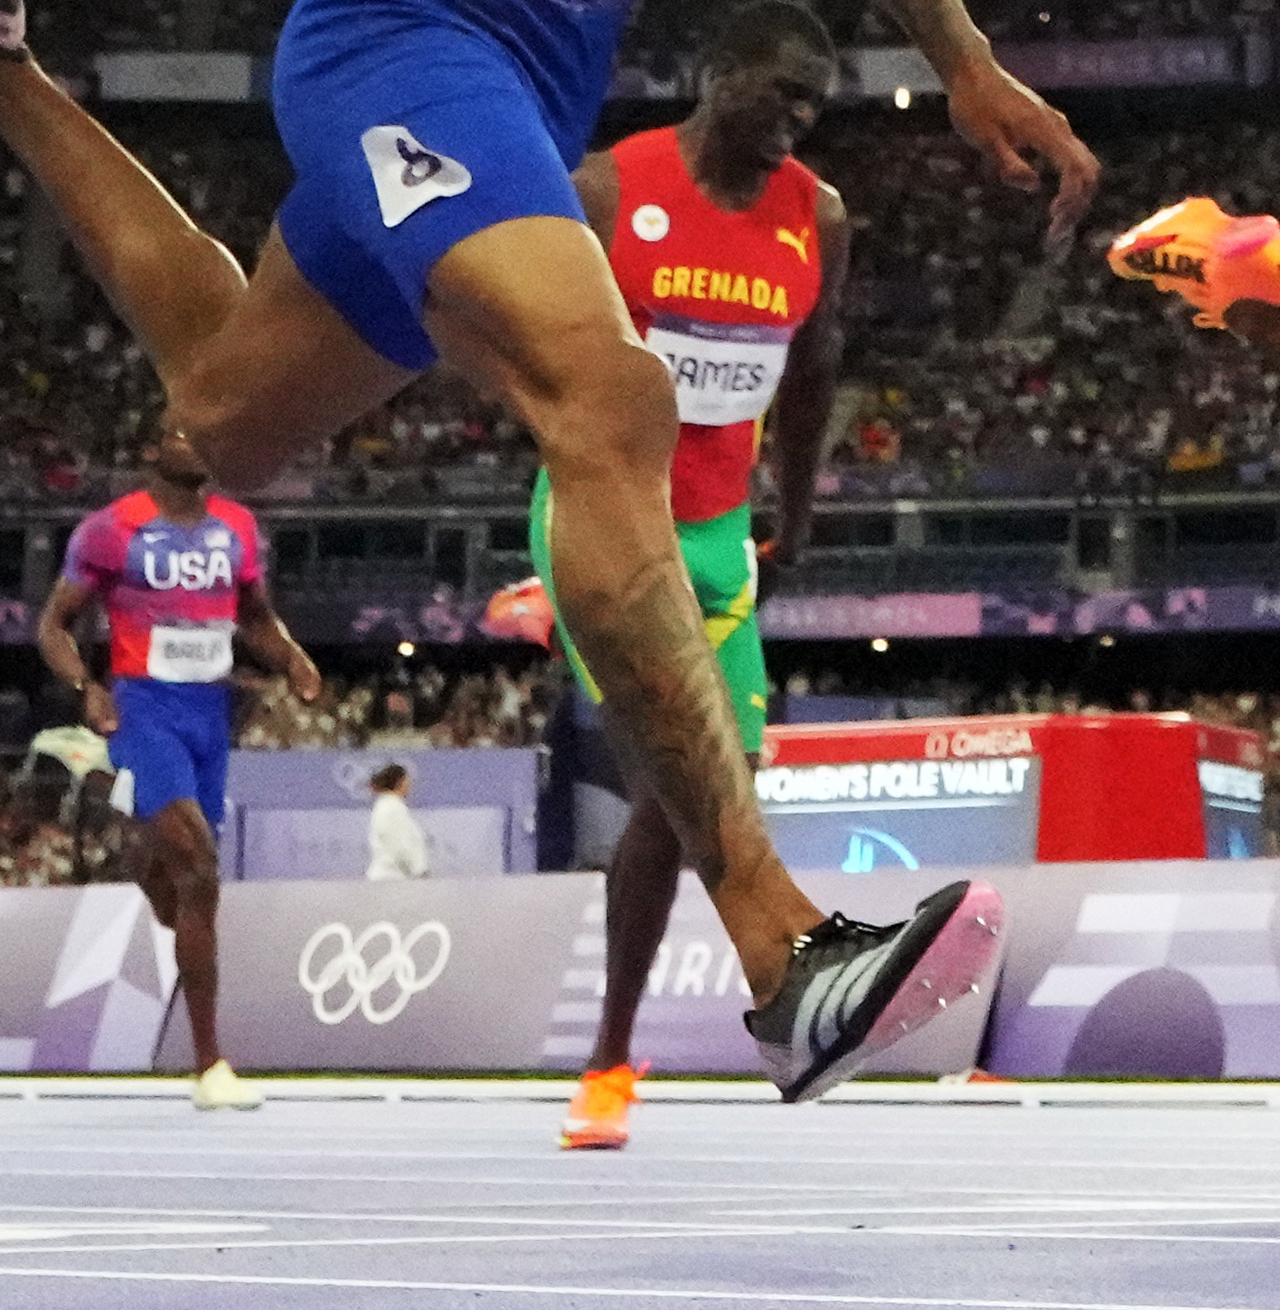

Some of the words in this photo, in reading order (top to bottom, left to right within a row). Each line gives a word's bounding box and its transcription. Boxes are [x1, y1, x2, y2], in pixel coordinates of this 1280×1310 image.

[652, 265, 789, 318] GRENADA
[144, 549, 233, 591] USA
[871, 759, 940, 798] POLE
[940, 756, 1031, 795] VAULT
